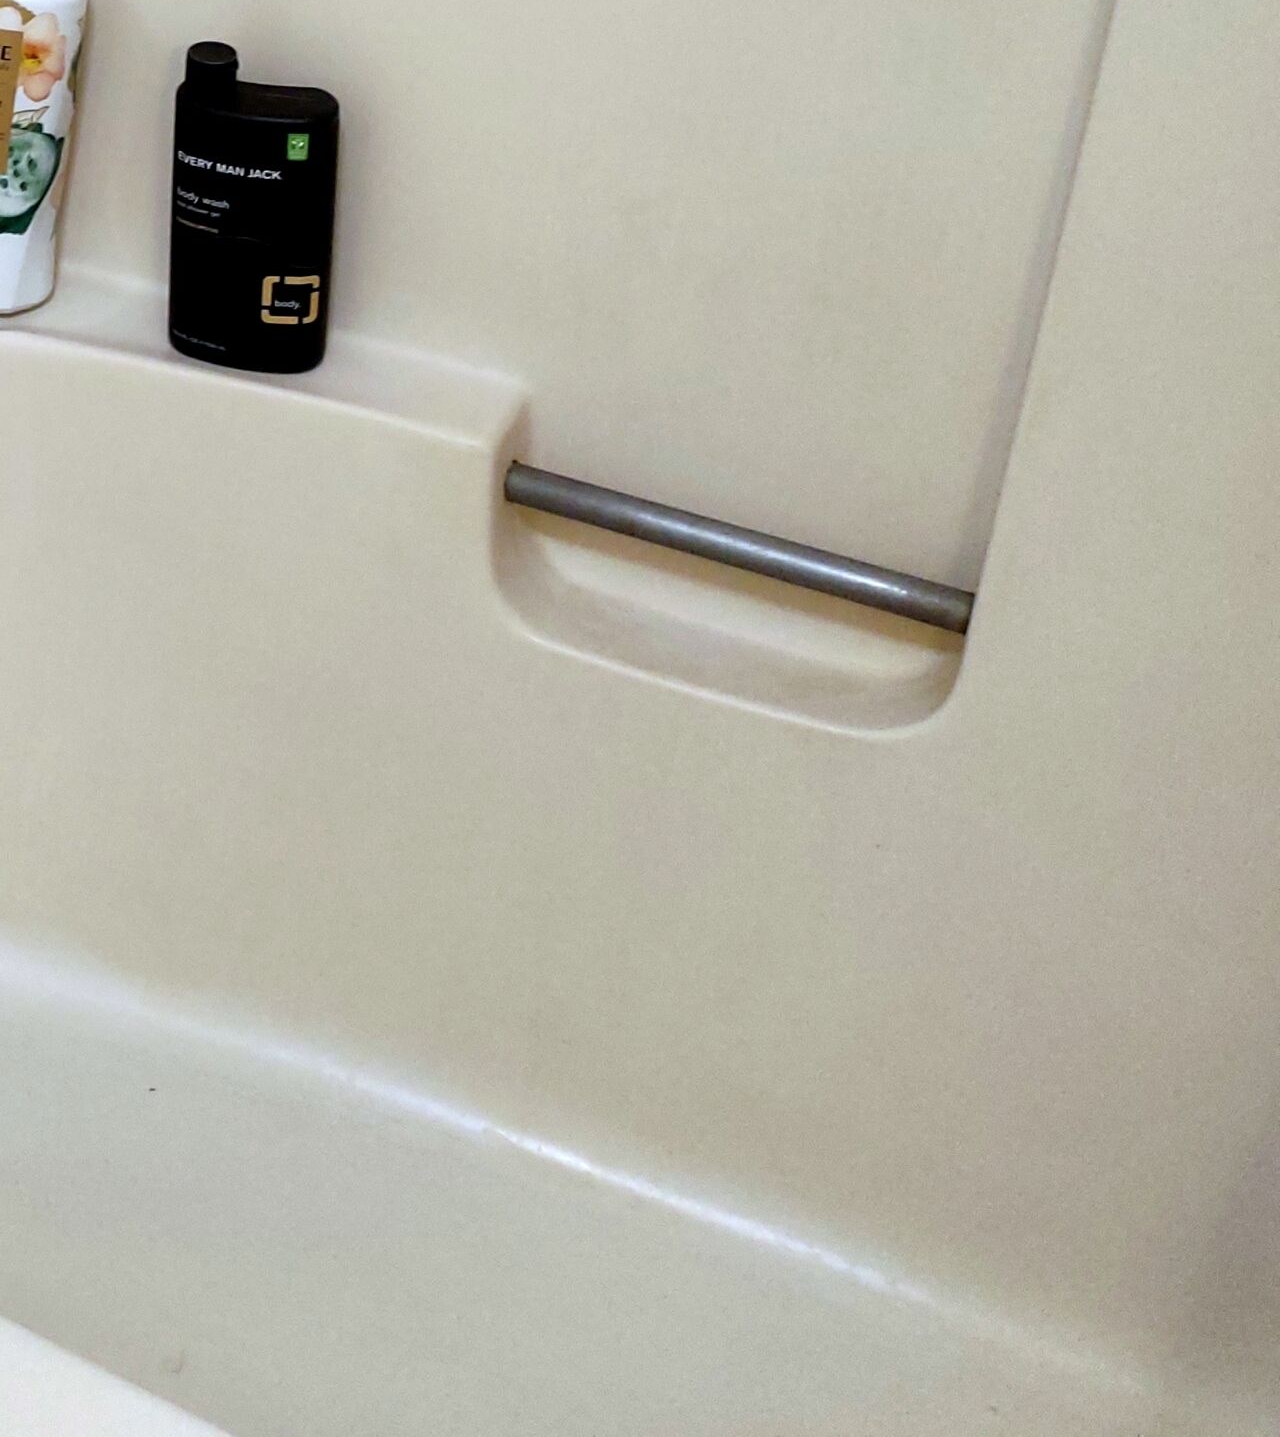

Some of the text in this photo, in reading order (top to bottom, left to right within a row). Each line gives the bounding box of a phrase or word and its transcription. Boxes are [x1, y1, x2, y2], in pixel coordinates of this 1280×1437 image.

[177, 150, 283, 181] EVERY MAN JACK
[176, 186, 199, 204] body
[202, 198, 230, 209] wash
